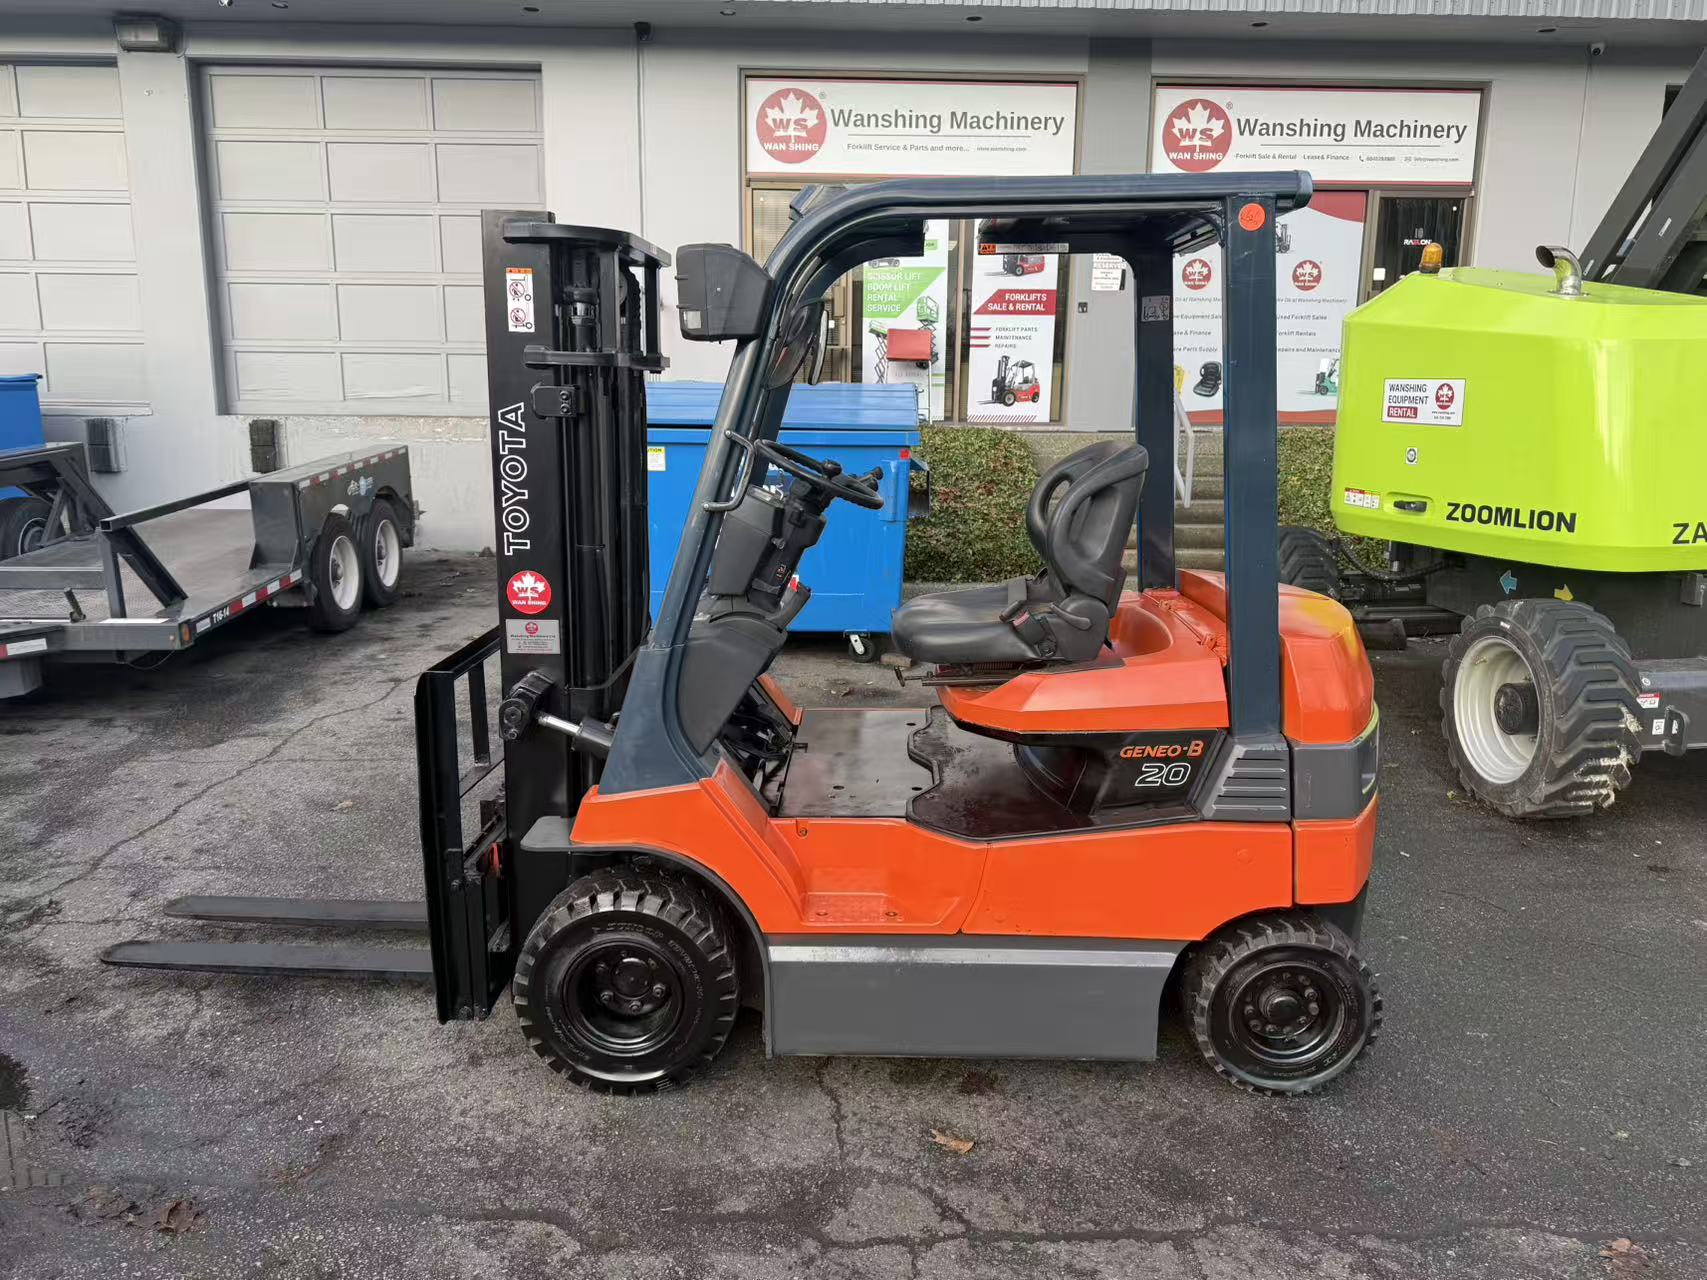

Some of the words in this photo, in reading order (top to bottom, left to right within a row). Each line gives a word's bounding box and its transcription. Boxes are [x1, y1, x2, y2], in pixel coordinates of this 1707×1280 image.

[772, 118, 809, 132] WS
[830, 108, 942, 133] Wanshing
[950, 111, 1065, 136] Machinery
[1178, 128, 1214, 142] WS
[1236, 118, 1346, 142] Wanshing
[1353, 120, 1467, 144] Machinery
[763, 142, 786, 151] WAN
[789, 143, 819, 152] SHING
[847, 143, 873, 151] Forklift
[909, 144, 929, 152] Parts
[1169, 151, 1191, 160] WAN
[1193, 151, 1223, 161] SHING
[1278, 153, 1297, 161] Rental
[1326, 154, 1350, 162] Finance
[904, 272, 921, 281] LIFT
[867, 282, 893, 291] BOOM
[894, 283, 911, 292] LIFT
[867, 293, 898, 302] RENTAL
[1005, 292, 1047, 301] FORKLIFTS
[867, 304, 901, 312] SERVICE
[987, 302, 1007, 311] SALE
[1008, 303, 1014, 311] &
[1016, 303, 1046, 311] RENTAL
[1388, 383, 1428, 393] WANSHING
[1388, 395, 1429, 405] EQUIPMENT
[1389, 407, 1416, 417] RENTAL
[498, 402, 530, 556] TOYOTA
[1446, 502, 1577, 533] ZOOMLION
[1120, 740, 1204, 758] GENEO-B
[1135, 763, 1191, 787] 20
